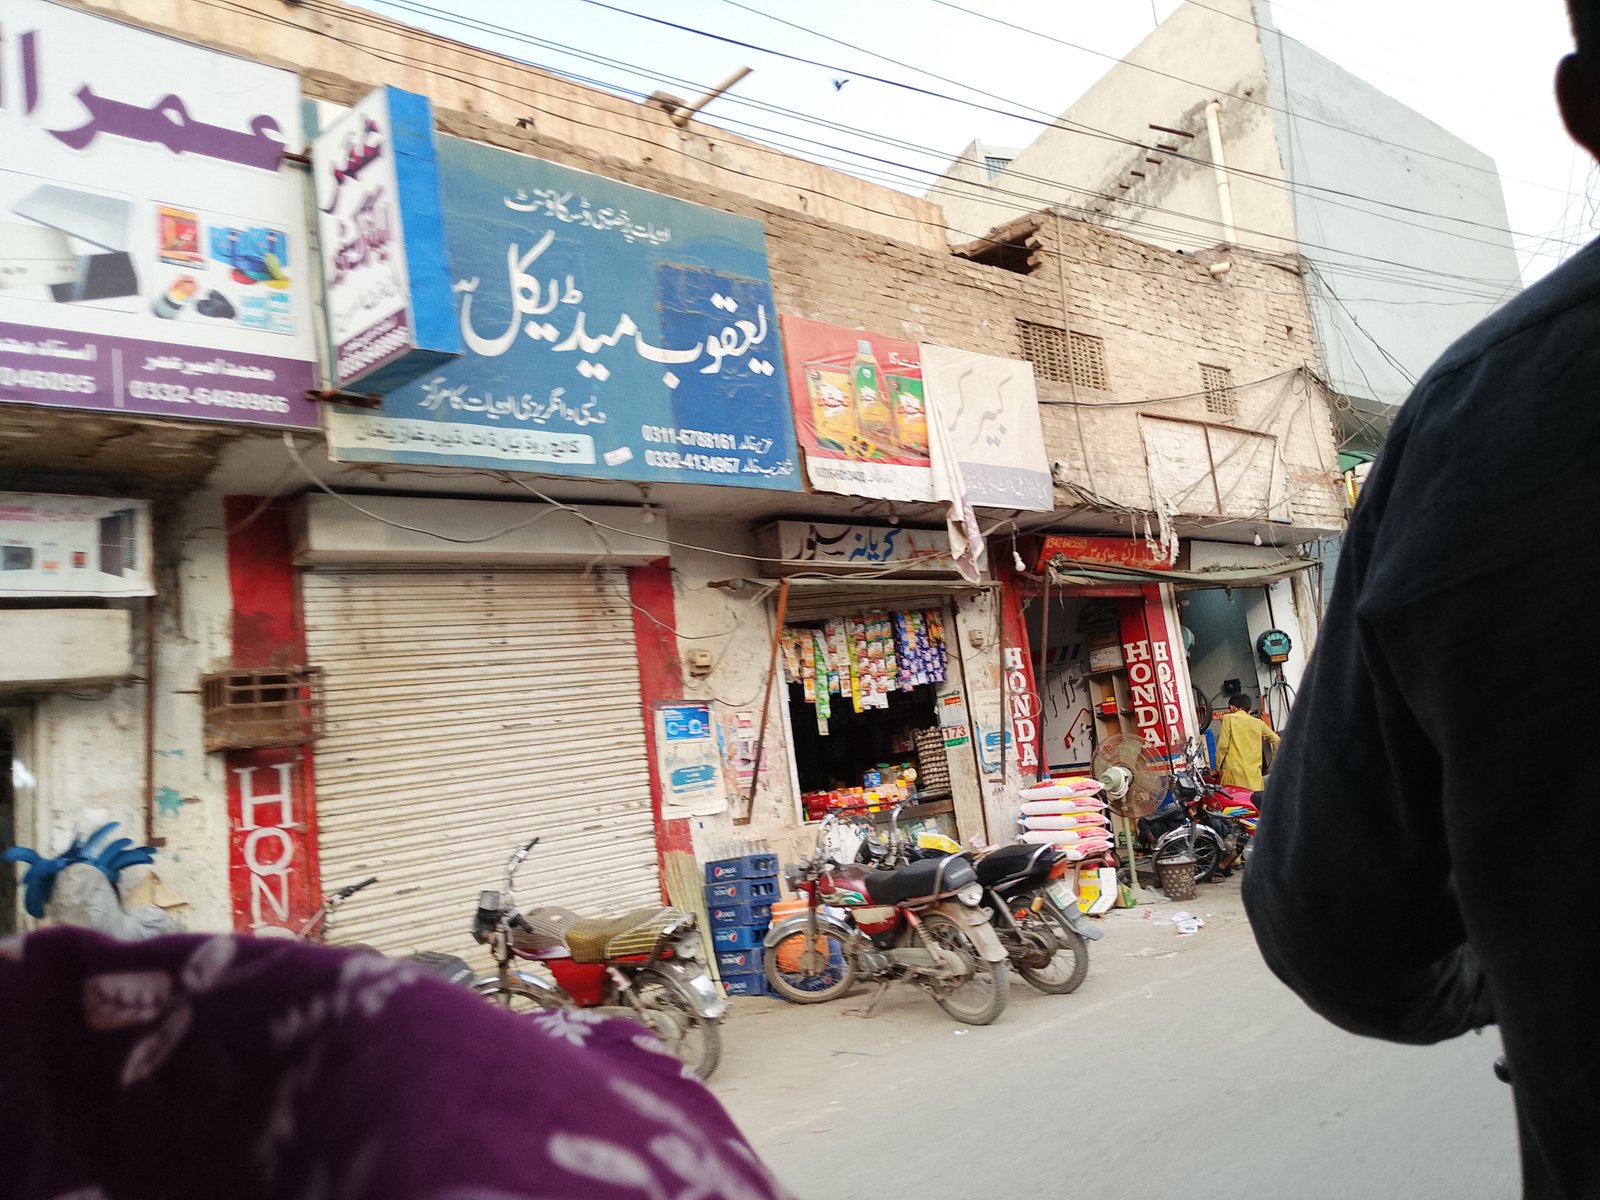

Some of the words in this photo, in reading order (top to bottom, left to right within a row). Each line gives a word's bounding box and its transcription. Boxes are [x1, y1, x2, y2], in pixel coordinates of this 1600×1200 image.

[460, 229, 638, 382] میڈیکل
[635, 292, 775, 389] یعقوب
[944, 726, 966, 739] 173
[1004, 646, 1039, 767] HONDA
[1123, 639, 1167, 749] HONDA
[1152, 641, 1182, 746] HONDA
[232, 762, 298, 938] HON
